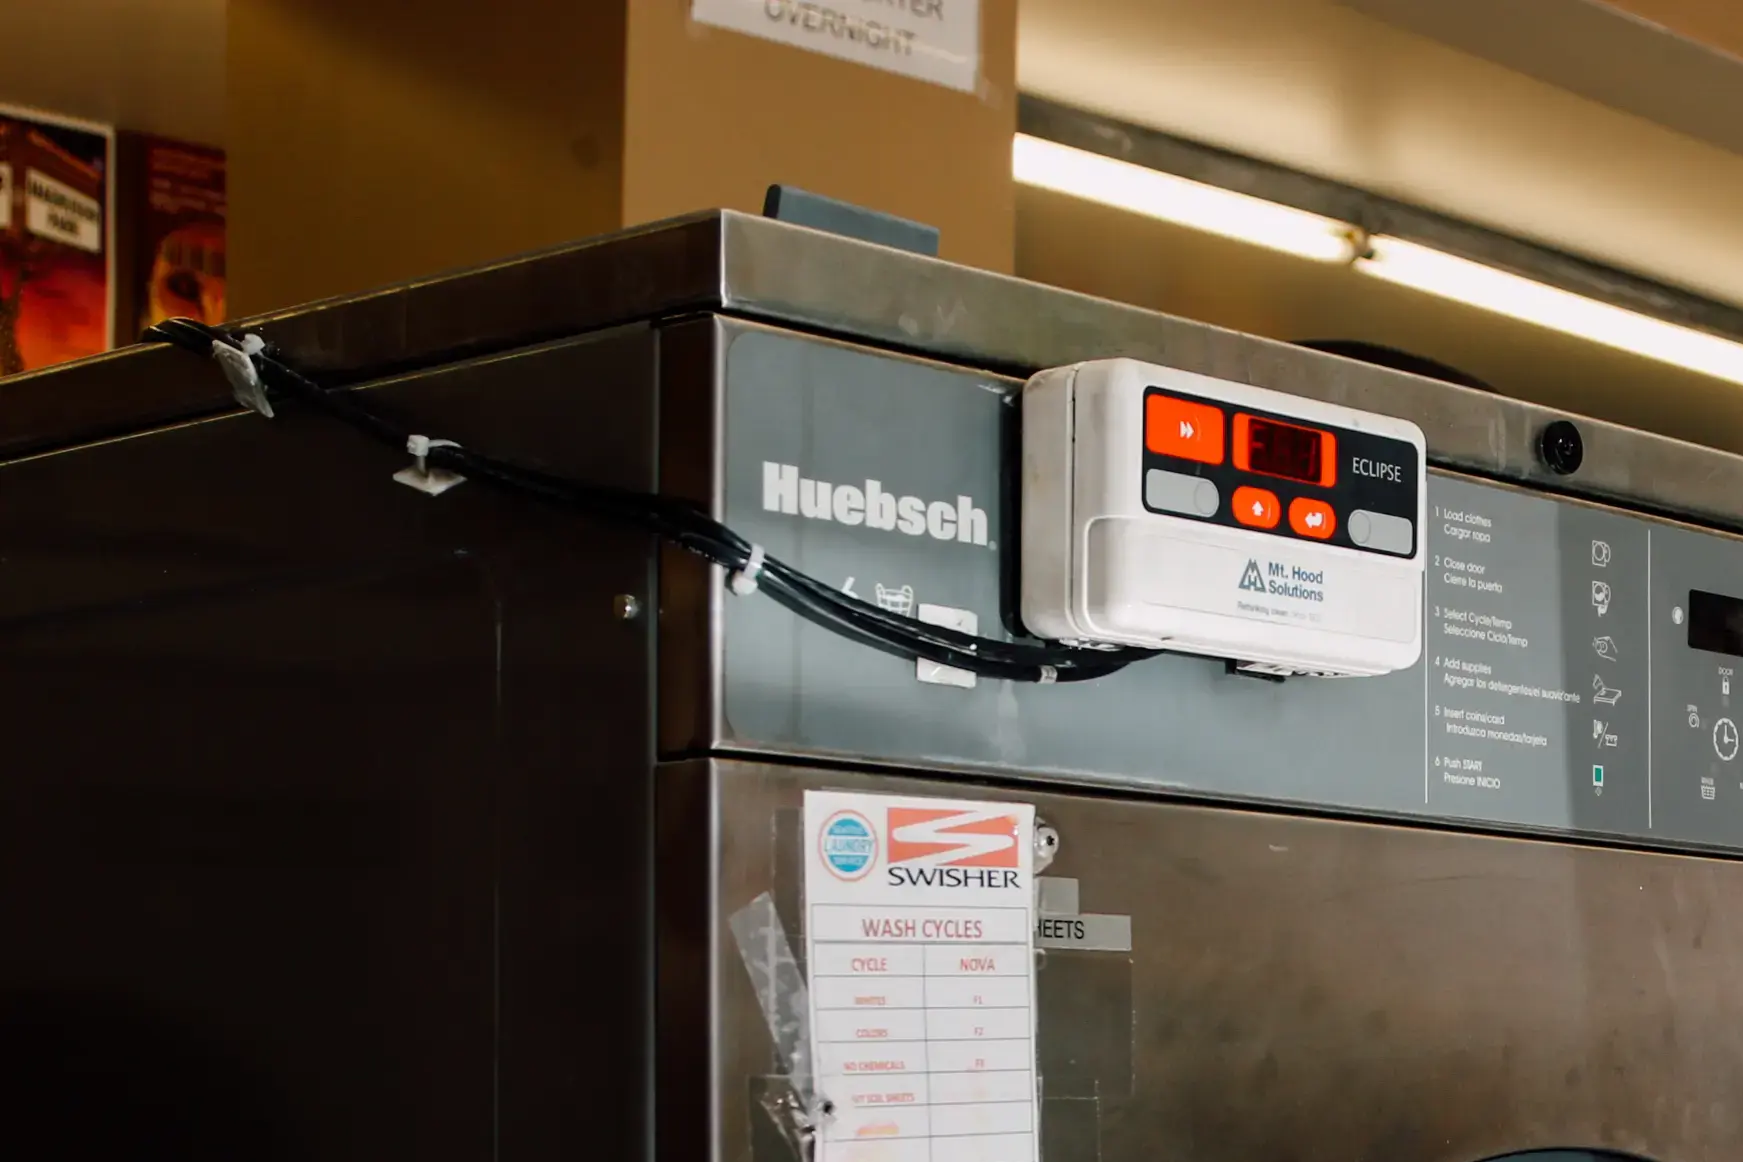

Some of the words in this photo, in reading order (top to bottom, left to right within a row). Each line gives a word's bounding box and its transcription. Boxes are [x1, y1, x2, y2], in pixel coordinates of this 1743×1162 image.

[1352, 457, 1402, 483] ECLIPSE
[762, 460, 989, 547] Huebsch
[1434, 506, 1440, 517] 1
[1443, 508, 1464, 522] Load
[1464, 513, 1492, 528] clothes
[1443, 523, 1471, 540] Cargar
[1472, 530, 1491, 543] ropa
[1268, 562, 1288, 579] Mt.
[1292, 565, 1324, 585] Hood
[1434, 555, 1440, 567] 2
[1443, 557, 1465, 571] Close
[1466, 562, 1486, 575] door
[1268, 579, 1324, 602] Solutions
[1434, 606, 1440, 617] 3
[1434, 656, 1440, 667] 4
[1443, 657, 1461, 670] Add
[1434, 706, 1440, 717] 5
[1434, 756, 1440, 767] 6
[1443, 757, 1462, 770] Push
[887, 866, 1021, 889] SWISHER
[862, 919, 917, 939] WASH
[922, 919, 983, 939] CYCLES
[851, 958, 888, 973] CYCLE
[960, 957, 996, 973] NOVA
